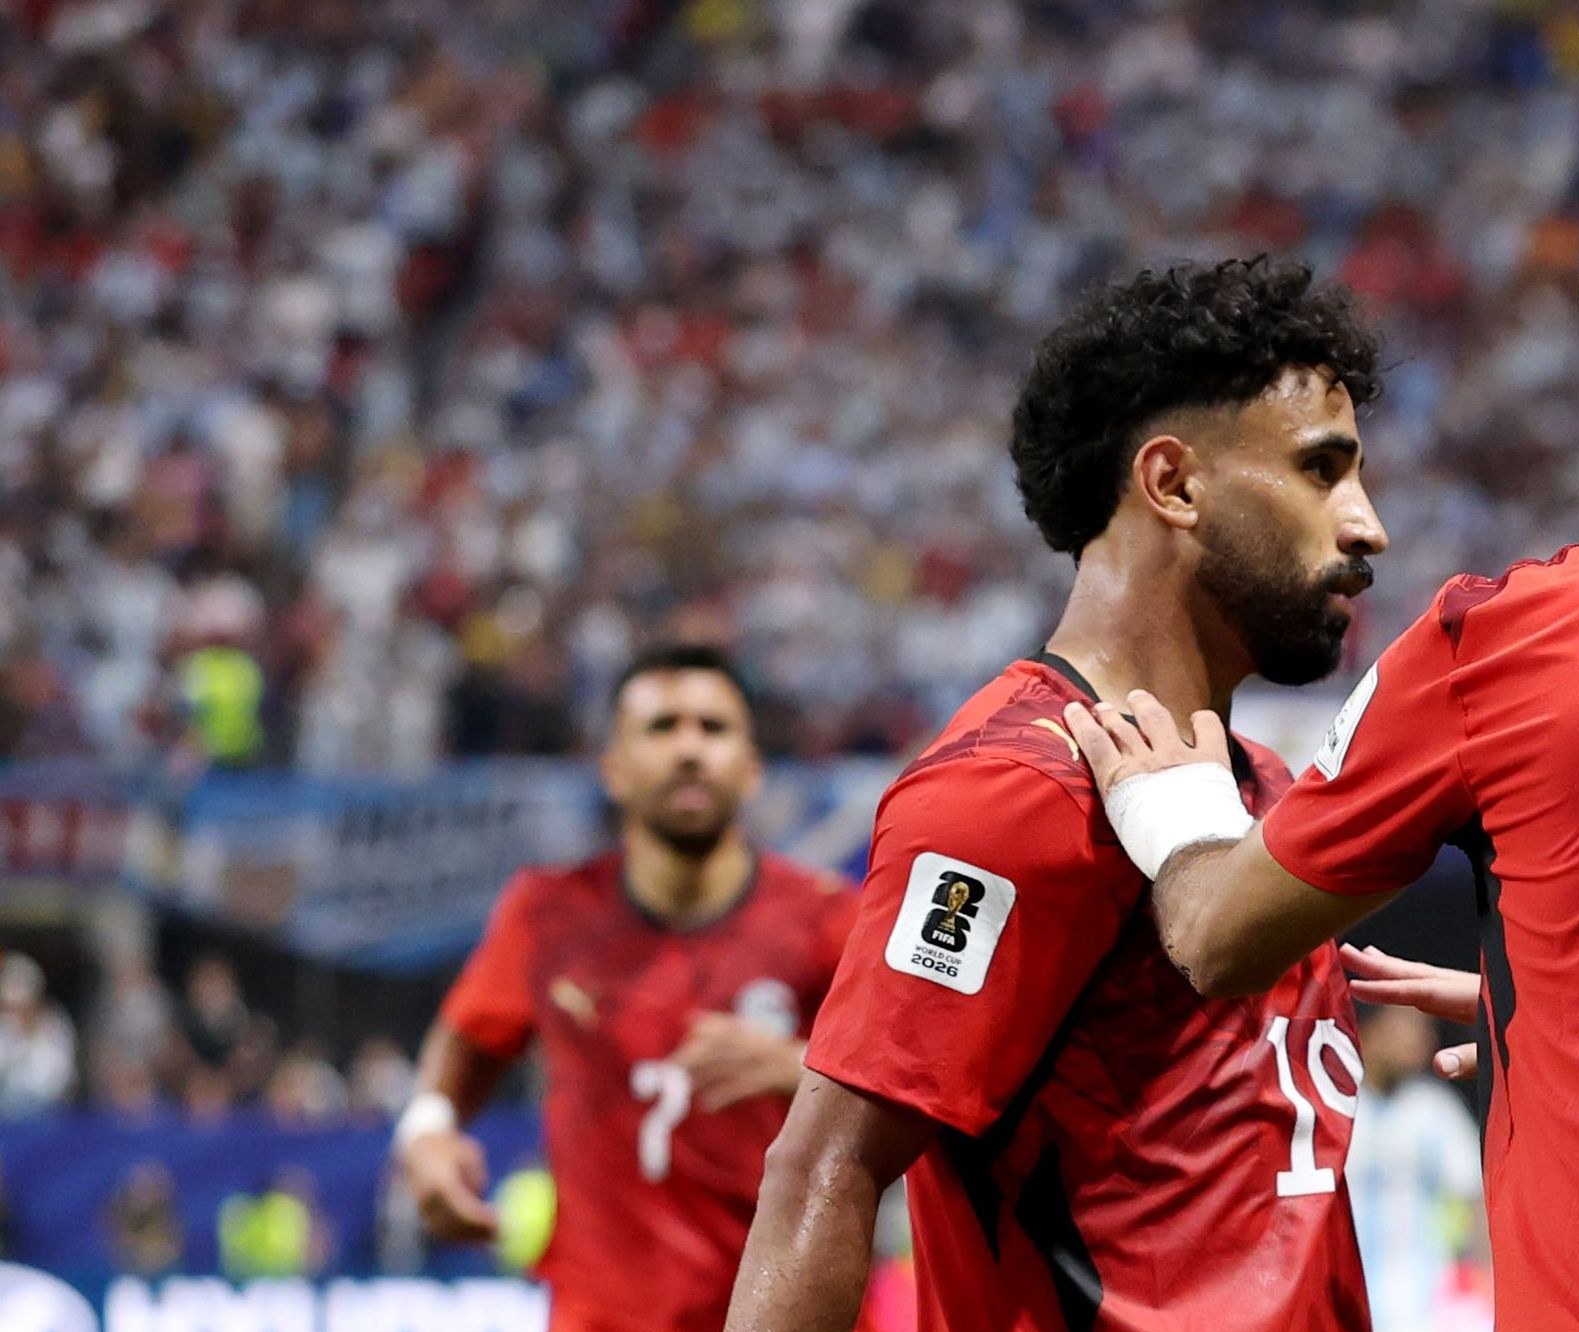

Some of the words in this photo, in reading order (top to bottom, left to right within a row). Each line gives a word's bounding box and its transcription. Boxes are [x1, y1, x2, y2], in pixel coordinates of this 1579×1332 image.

[932, 930, 955, 946] FIFA
[911, 953, 959, 978] 2026
[915, 946, 945, 959] WORLD
[945, 953, 962, 966] CUP
[629, 1058, 692, 1181] 7
